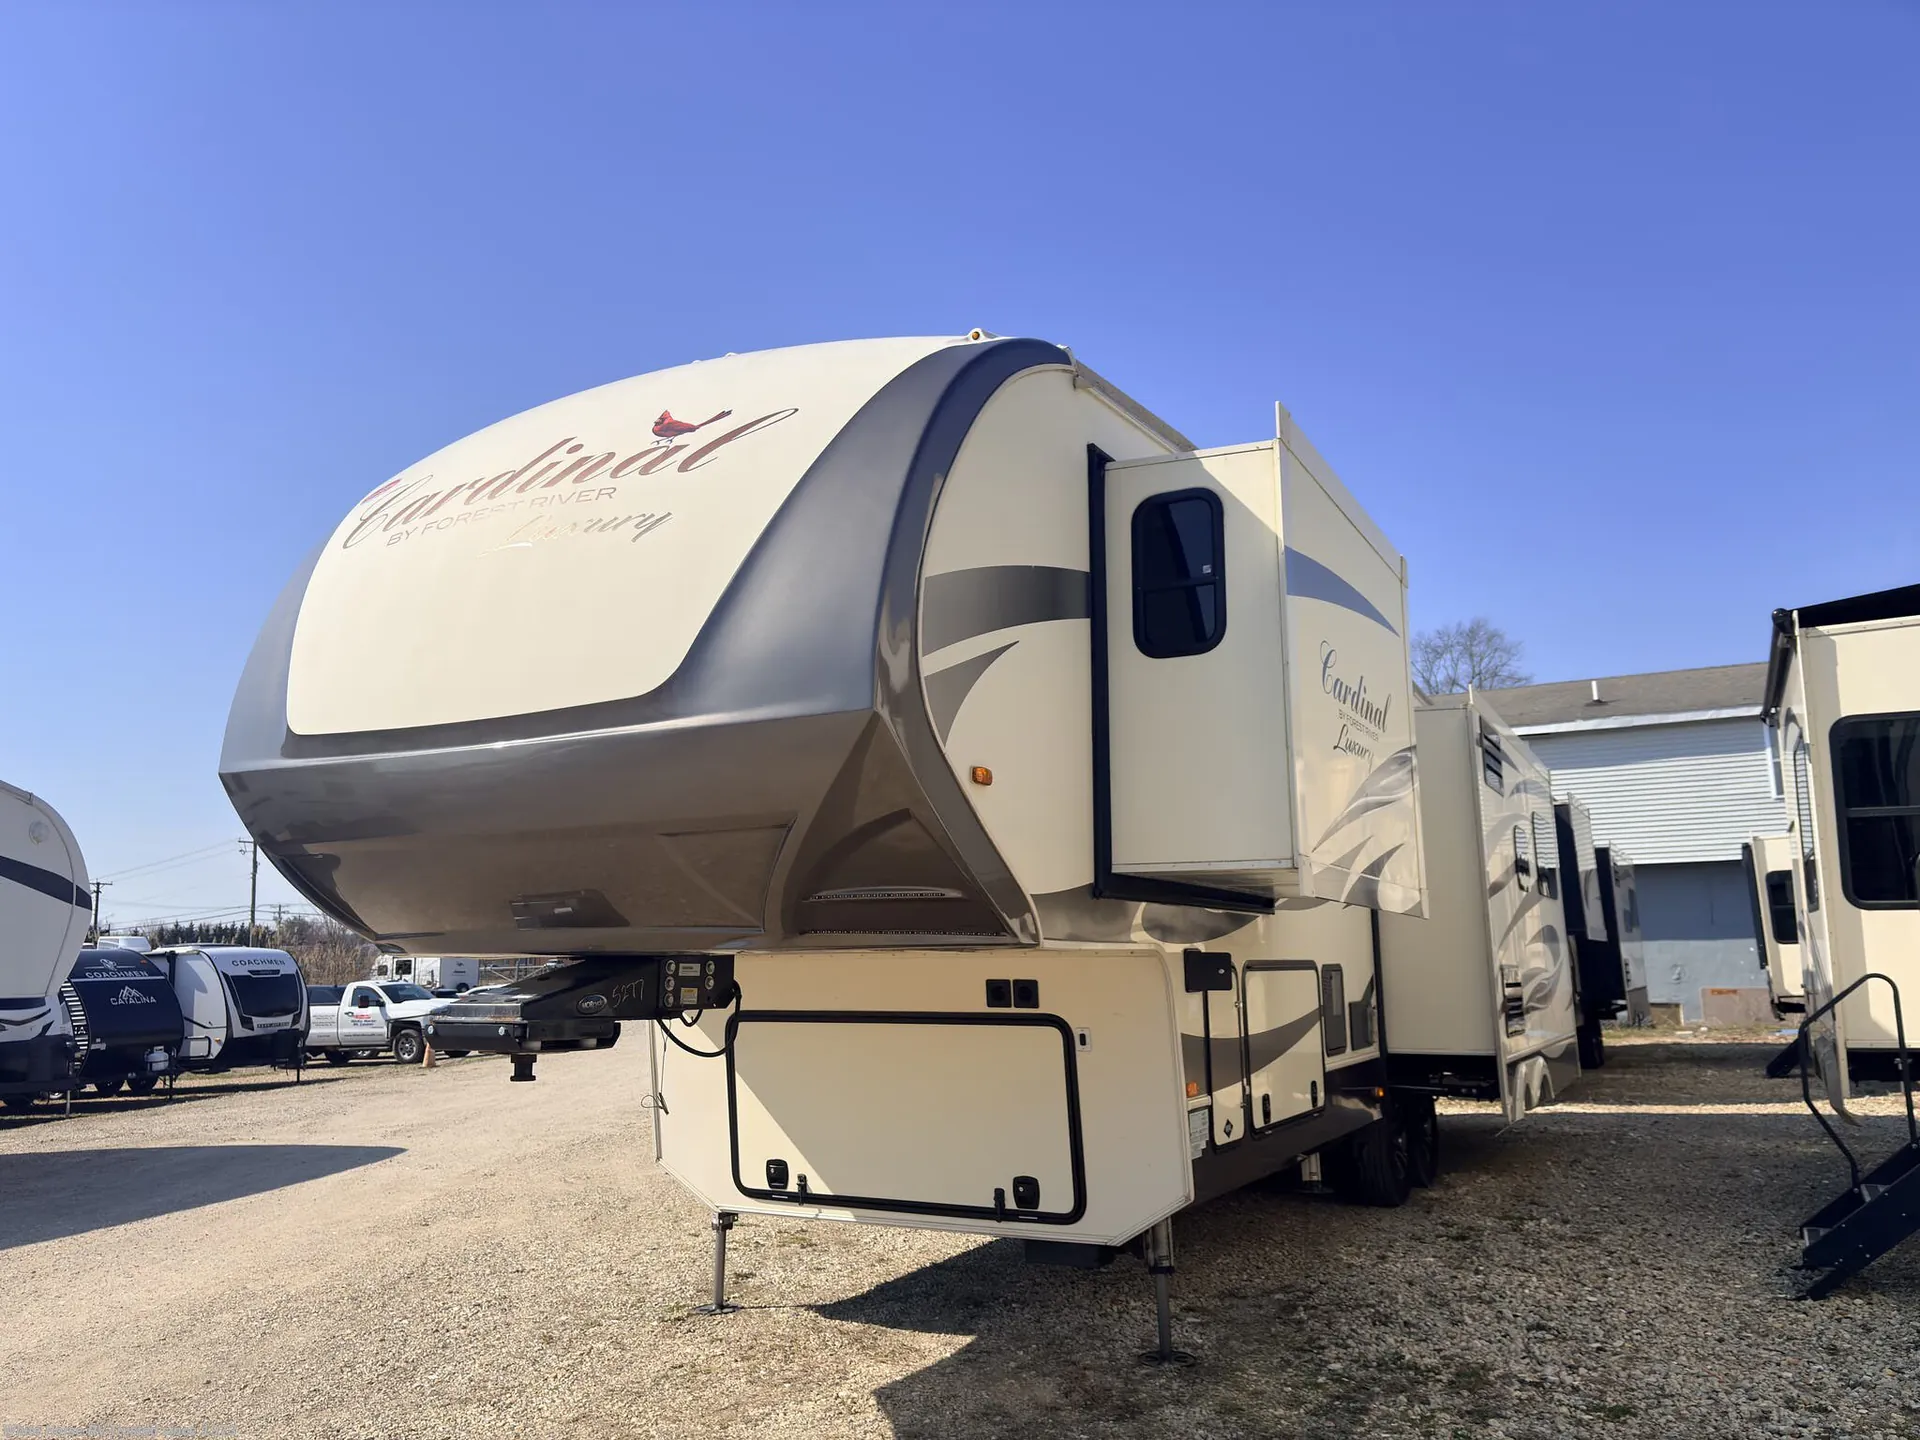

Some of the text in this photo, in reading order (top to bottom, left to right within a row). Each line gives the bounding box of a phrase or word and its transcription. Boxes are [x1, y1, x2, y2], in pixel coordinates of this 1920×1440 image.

[342, 407, 799, 549] Cardinal
[386, 486, 617, 546] BY FOREST RIVER
[1320, 640, 1391, 733] Cardinal
[1333, 724, 1374, 773] Luxury
[85, 970, 149, 979] COACHMEN
[231, 959, 286, 968] COACHMEN
[110, 996, 157, 1006] CATALINA
